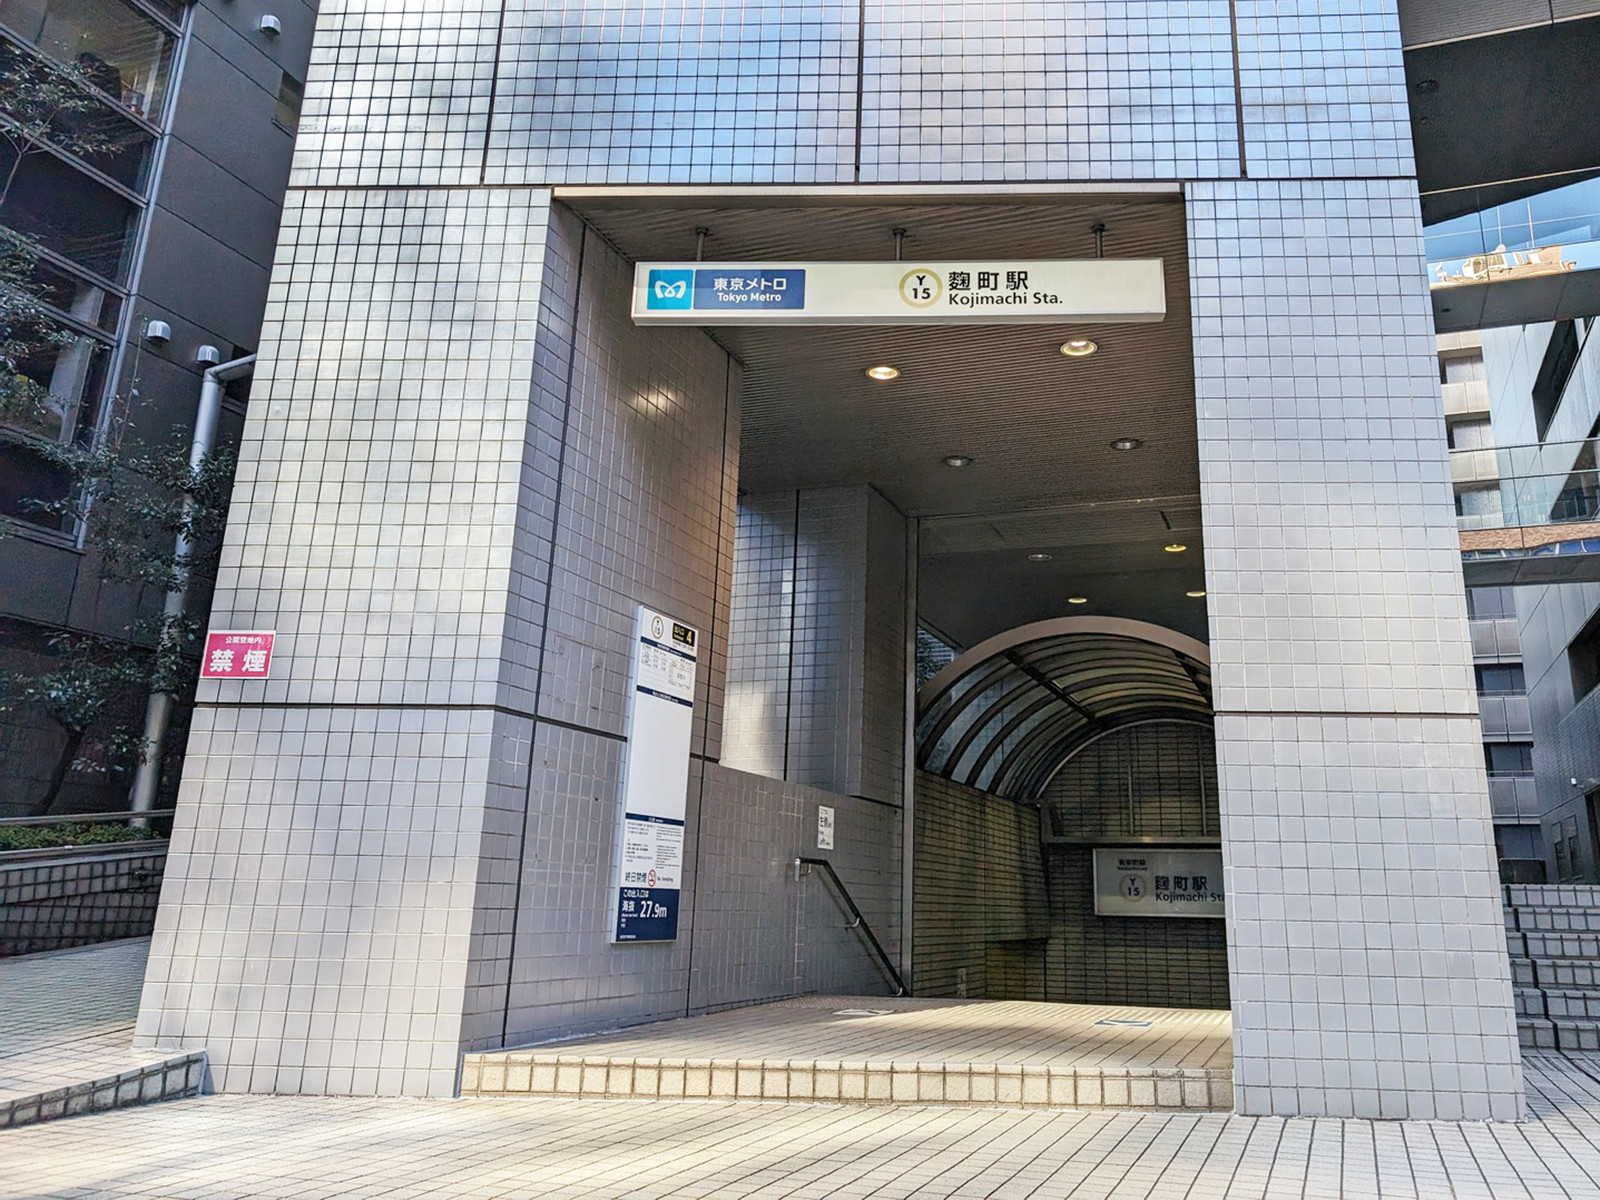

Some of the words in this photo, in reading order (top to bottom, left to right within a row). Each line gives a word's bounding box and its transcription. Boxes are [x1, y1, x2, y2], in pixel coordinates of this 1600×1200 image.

[713, 277, 787, 291] 東京メトロ
[916, 275, 926, 286] Y
[717, 292, 748, 303] Tokyo
[750, 292, 782, 302] Metro
[912, 288, 931, 299] 15
[949, 292, 1028, 308] Kojimachi
[1033, 292, 1063, 304] Sta.
[225, 636, 262, 644] 公開空地内
[687, 630, 692, 643] 4
[209, 649, 268, 672] 禁煙
[1129, 878, 1136, 886] Y
[1127, 887, 1140, 896] 15
[1155, 891, 1208, 903] Kojimachi
[622, 900, 635, 911] 海抜
[639, 900, 667, 917] 27.9m
